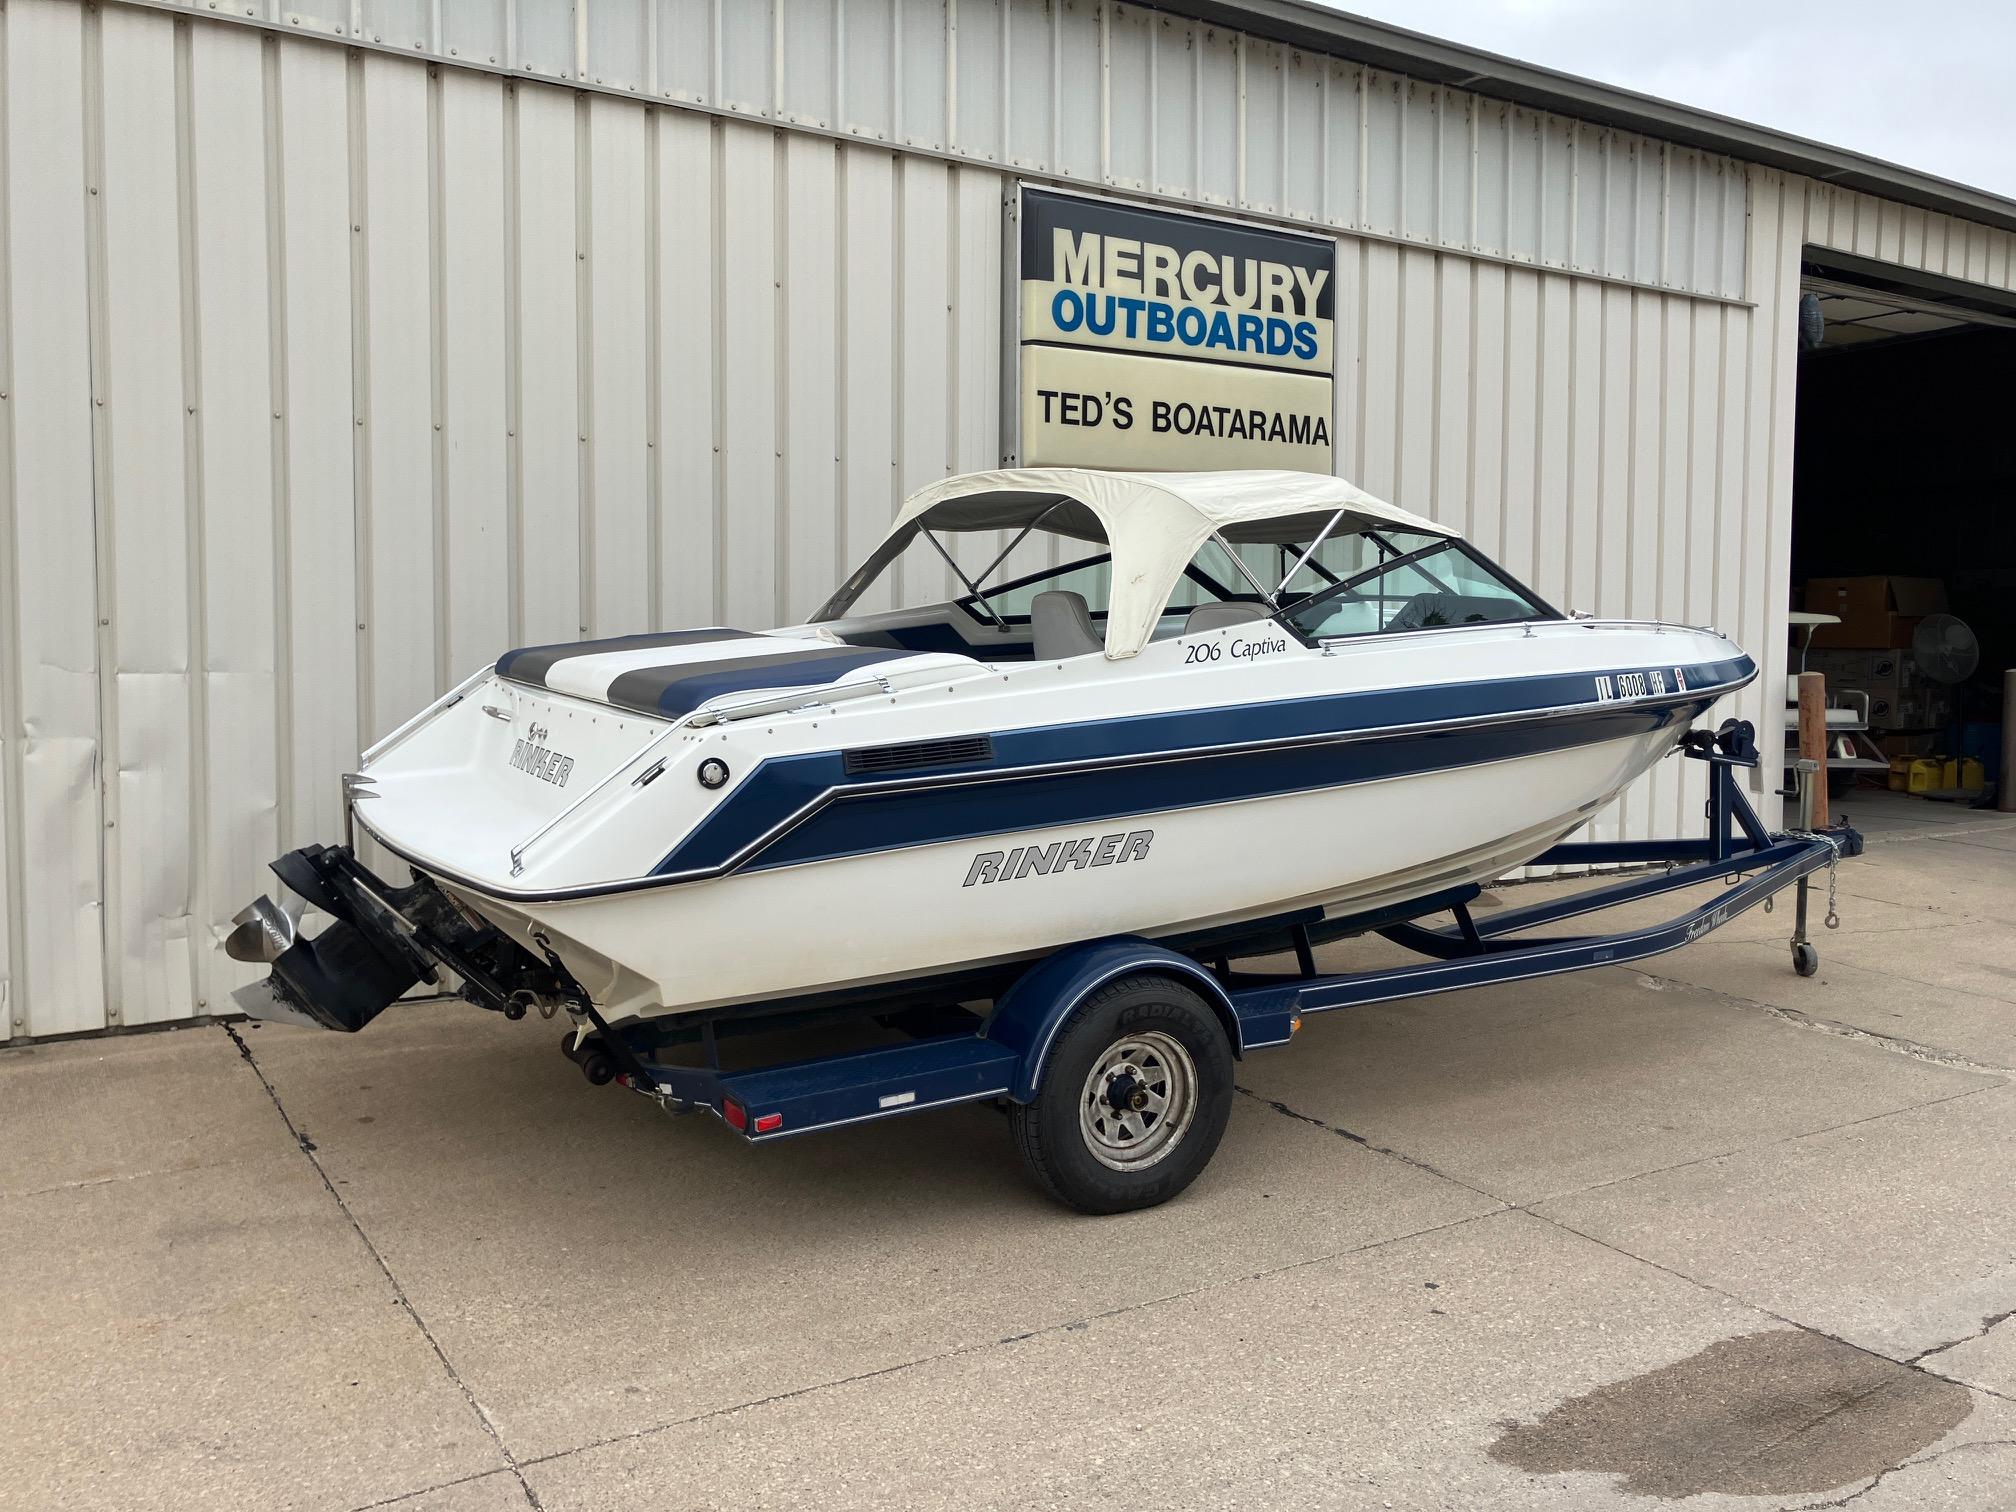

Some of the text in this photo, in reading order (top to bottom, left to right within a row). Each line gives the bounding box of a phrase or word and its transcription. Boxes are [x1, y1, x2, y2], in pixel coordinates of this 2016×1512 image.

[1053, 227, 1330, 317] MERCURY
[1052, 289, 1318, 360] OUTBOARDS
[1037, 390, 1330, 446] TED'S BOATARAMA
[1184, 637, 1286, 664] 206 Captiva
[1618, 674, 1646, 698] 6008
[509, 738, 575, 788] RINKER
[962, 829, 1154, 888] RINKER
